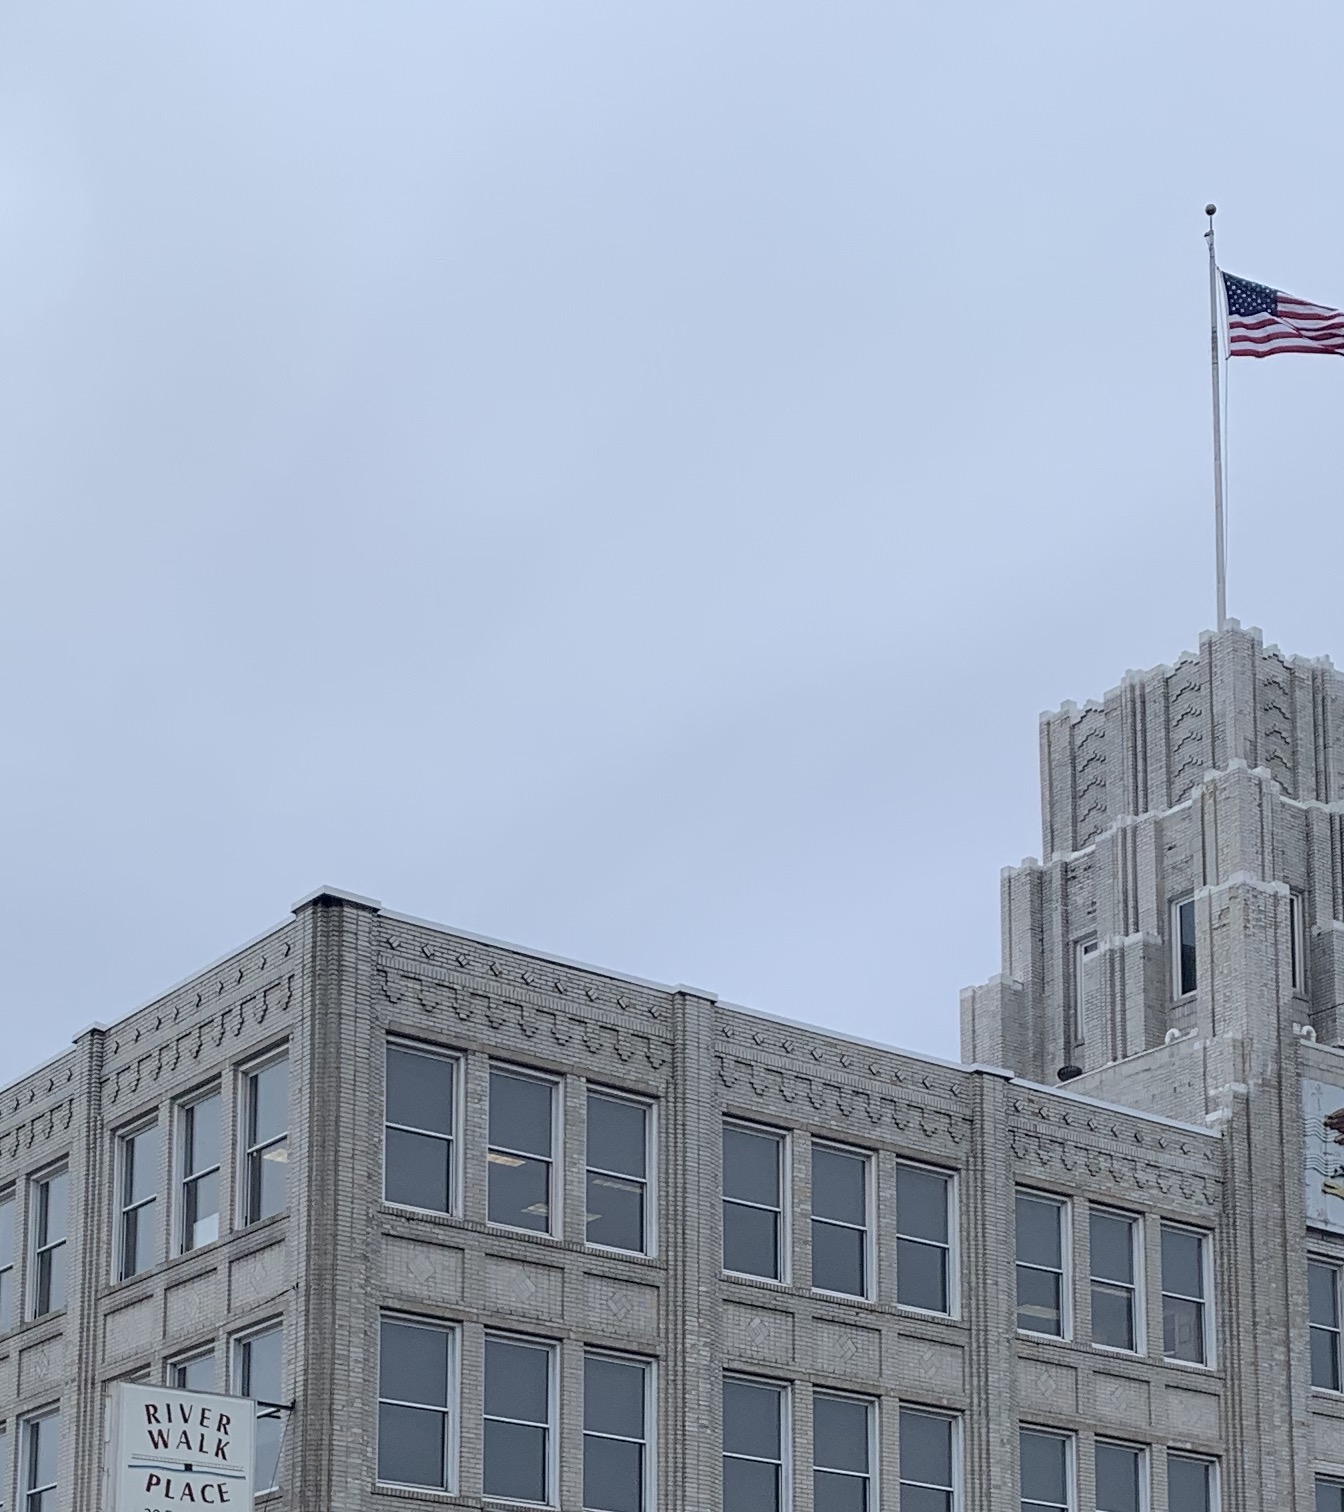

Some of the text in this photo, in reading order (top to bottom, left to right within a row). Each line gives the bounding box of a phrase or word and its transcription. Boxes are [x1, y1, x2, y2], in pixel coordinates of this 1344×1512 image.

[144, 1402, 232, 1436] RIVER
[147, 1428, 230, 1461] WALK
[145, 1472, 231, 1504] PLACE
